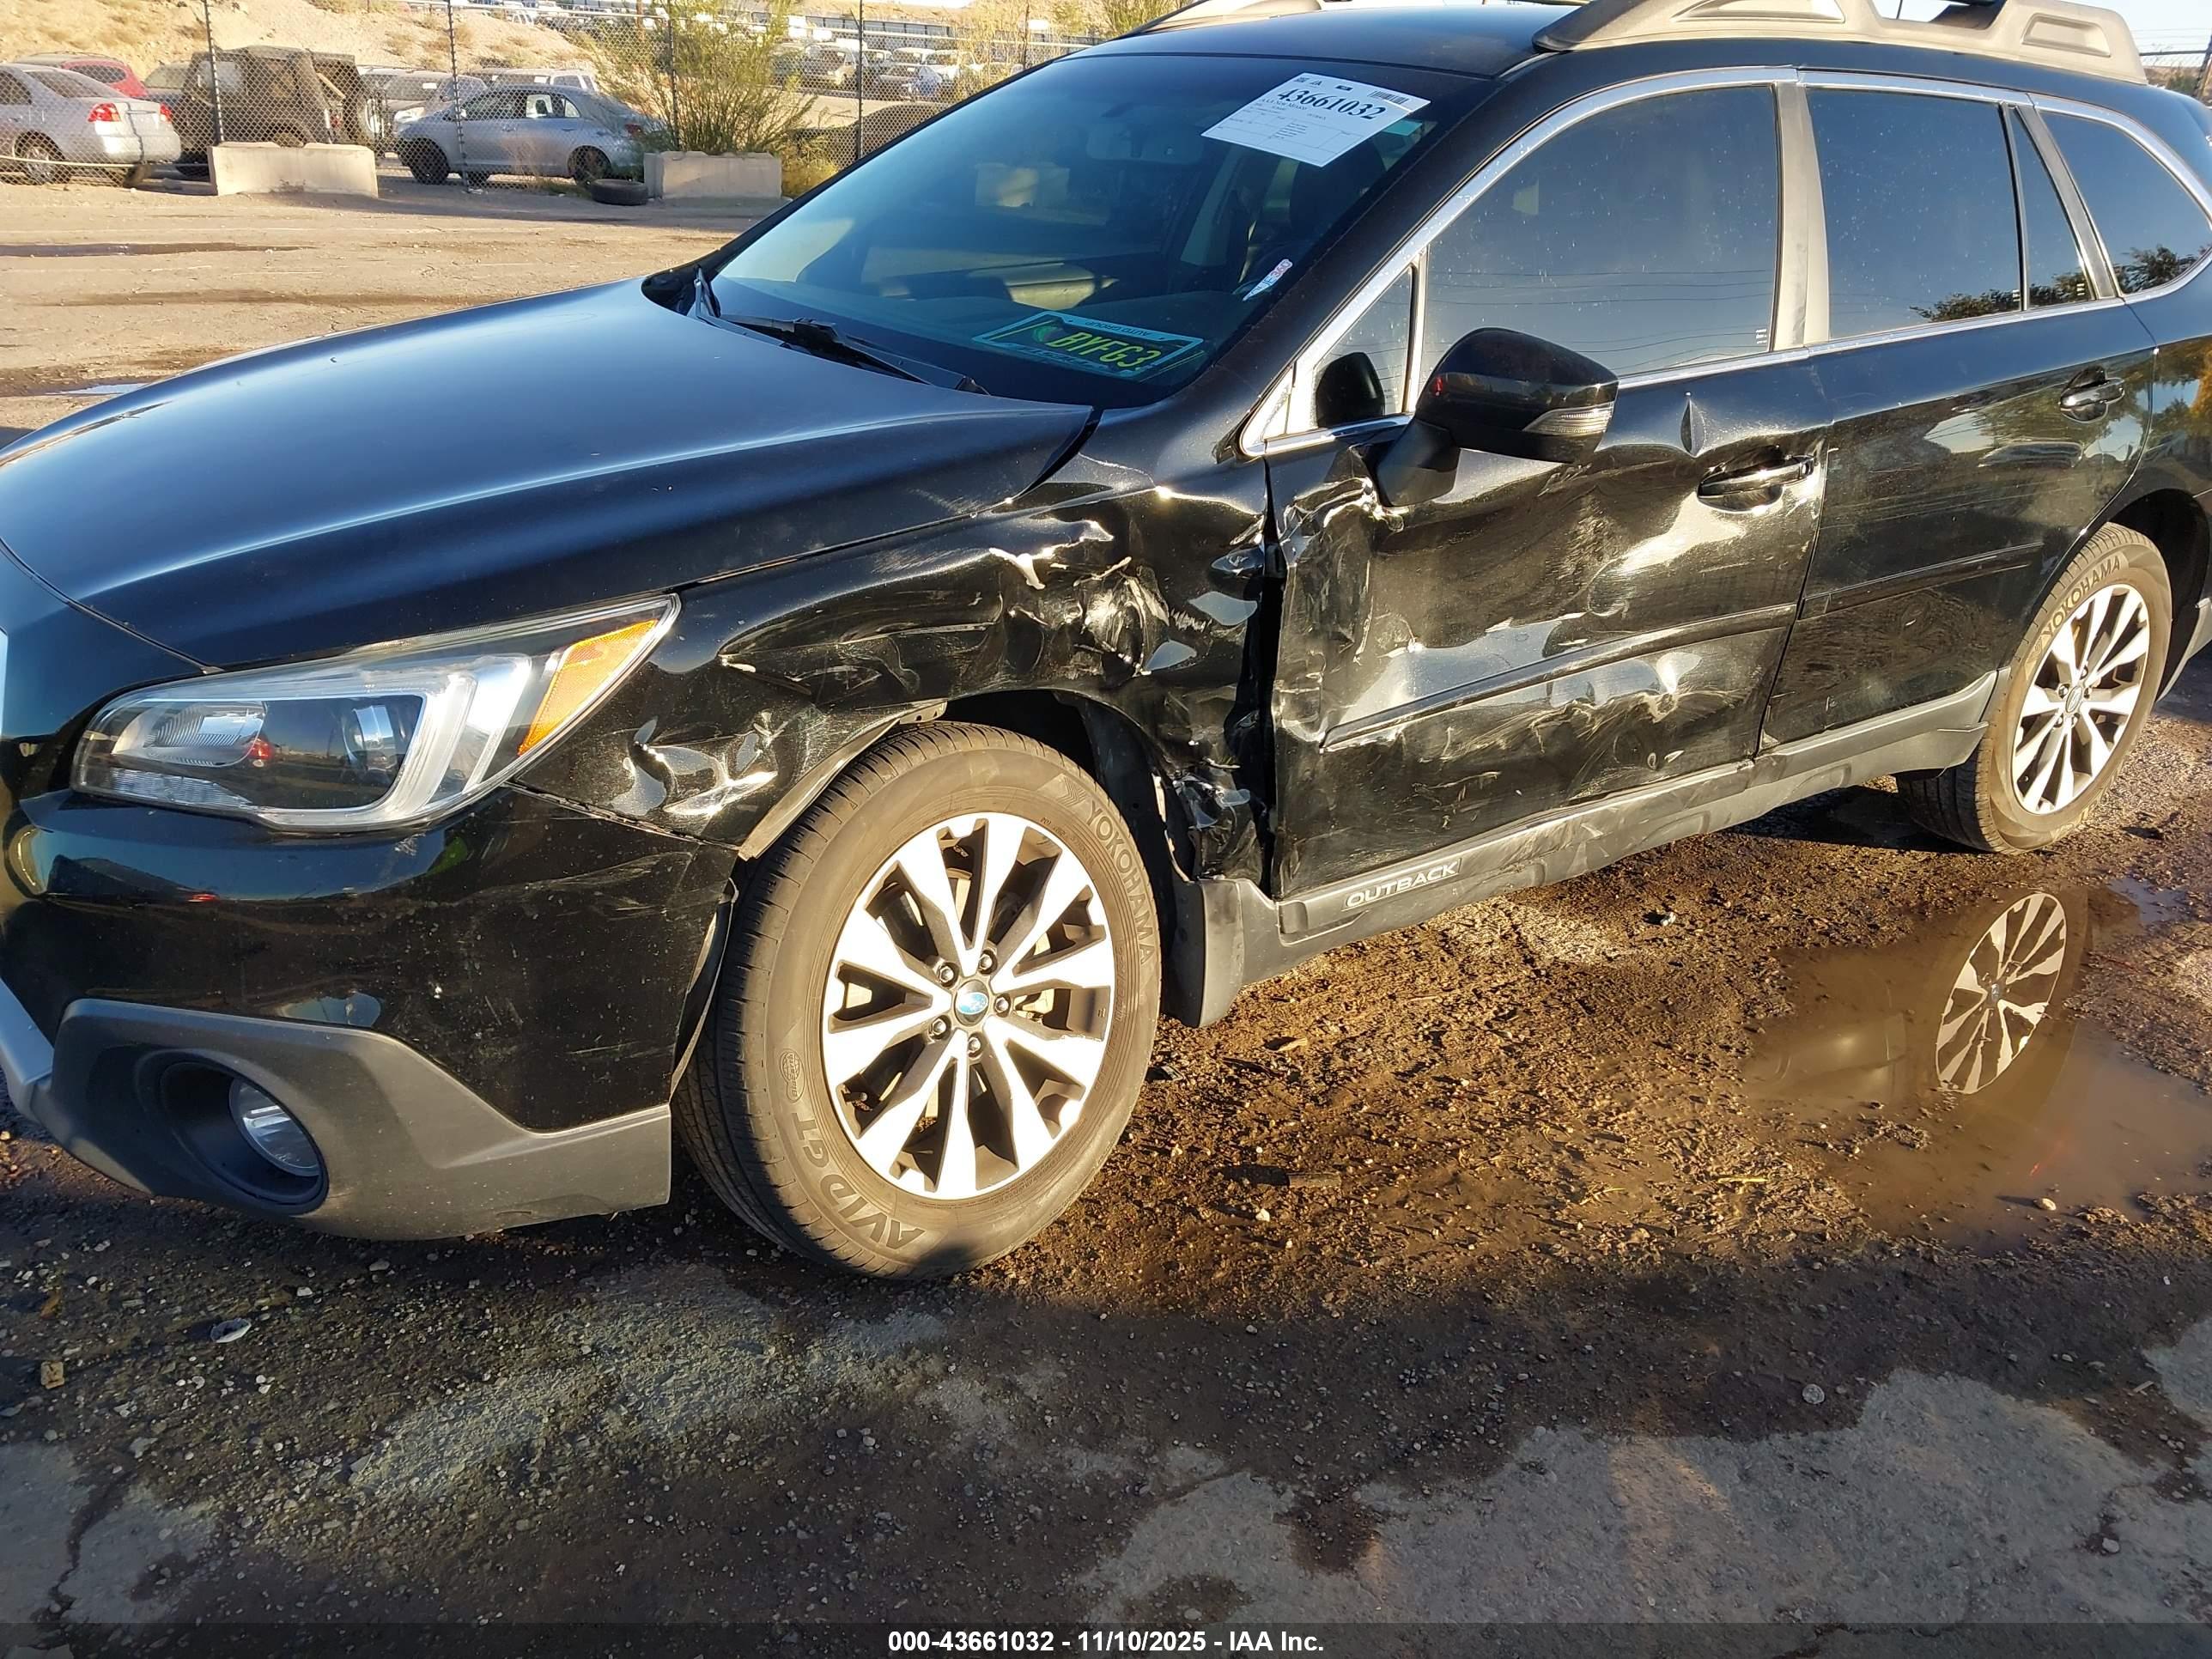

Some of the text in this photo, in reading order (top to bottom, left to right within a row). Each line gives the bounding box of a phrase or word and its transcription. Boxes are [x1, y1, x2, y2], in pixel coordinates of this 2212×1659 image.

[1278, 88, 1387, 119] 43661032
[1045, 331, 1162, 368] BYFG3
[1085, 320, 1152, 337] AUTO GROUP
[2040, 555, 2121, 638] YOKOHAMA
[1086, 799, 1156, 965] YOKOHAMA
[1346, 860, 1458, 908] OUTBACK
[791, 1111, 926, 1251] AVID GT
